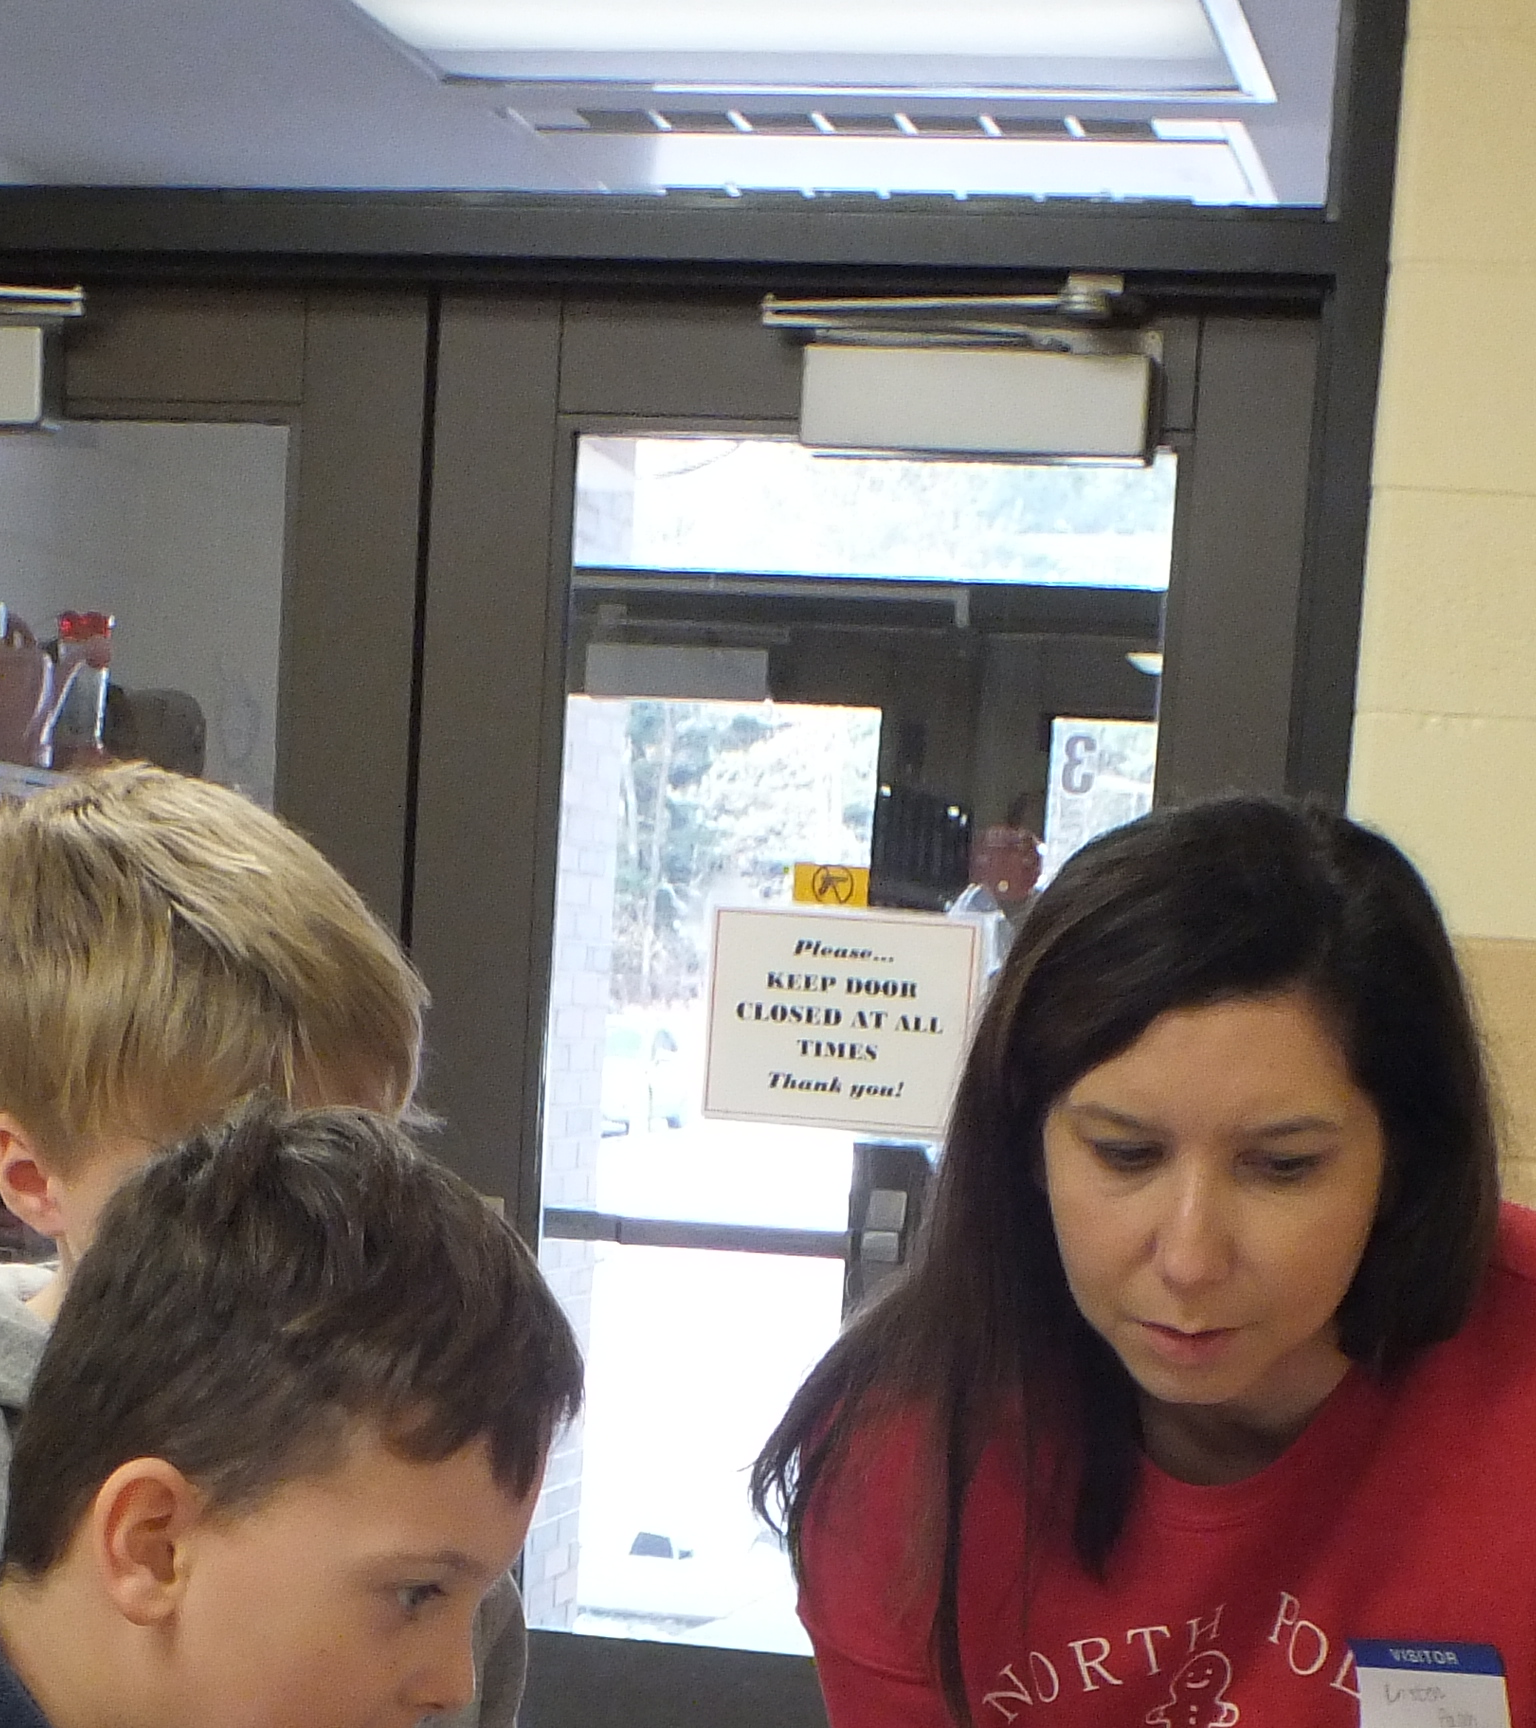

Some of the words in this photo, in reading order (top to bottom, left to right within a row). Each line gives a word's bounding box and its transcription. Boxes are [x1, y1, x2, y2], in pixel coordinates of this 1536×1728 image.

[793, 938, 895, 963] Please...
[767, 971, 836, 993] KEEP
[845, 977, 918, 998] DOOR
[736, 1002, 842, 1027] CLOSED
[851, 1010, 888, 1029] AT
[894, 1014, 944, 1034] ALL
[797, 1039, 878, 1061] TIMES
[768, 1071, 842, 1094] Thank
[849, 1081, 904, 1099] you!
[982, 1603, 1226, 1725] NORTH
[1268, 1591, 1362, 1699] POL
[1389, 1649, 1459, 1665] VISITOR
